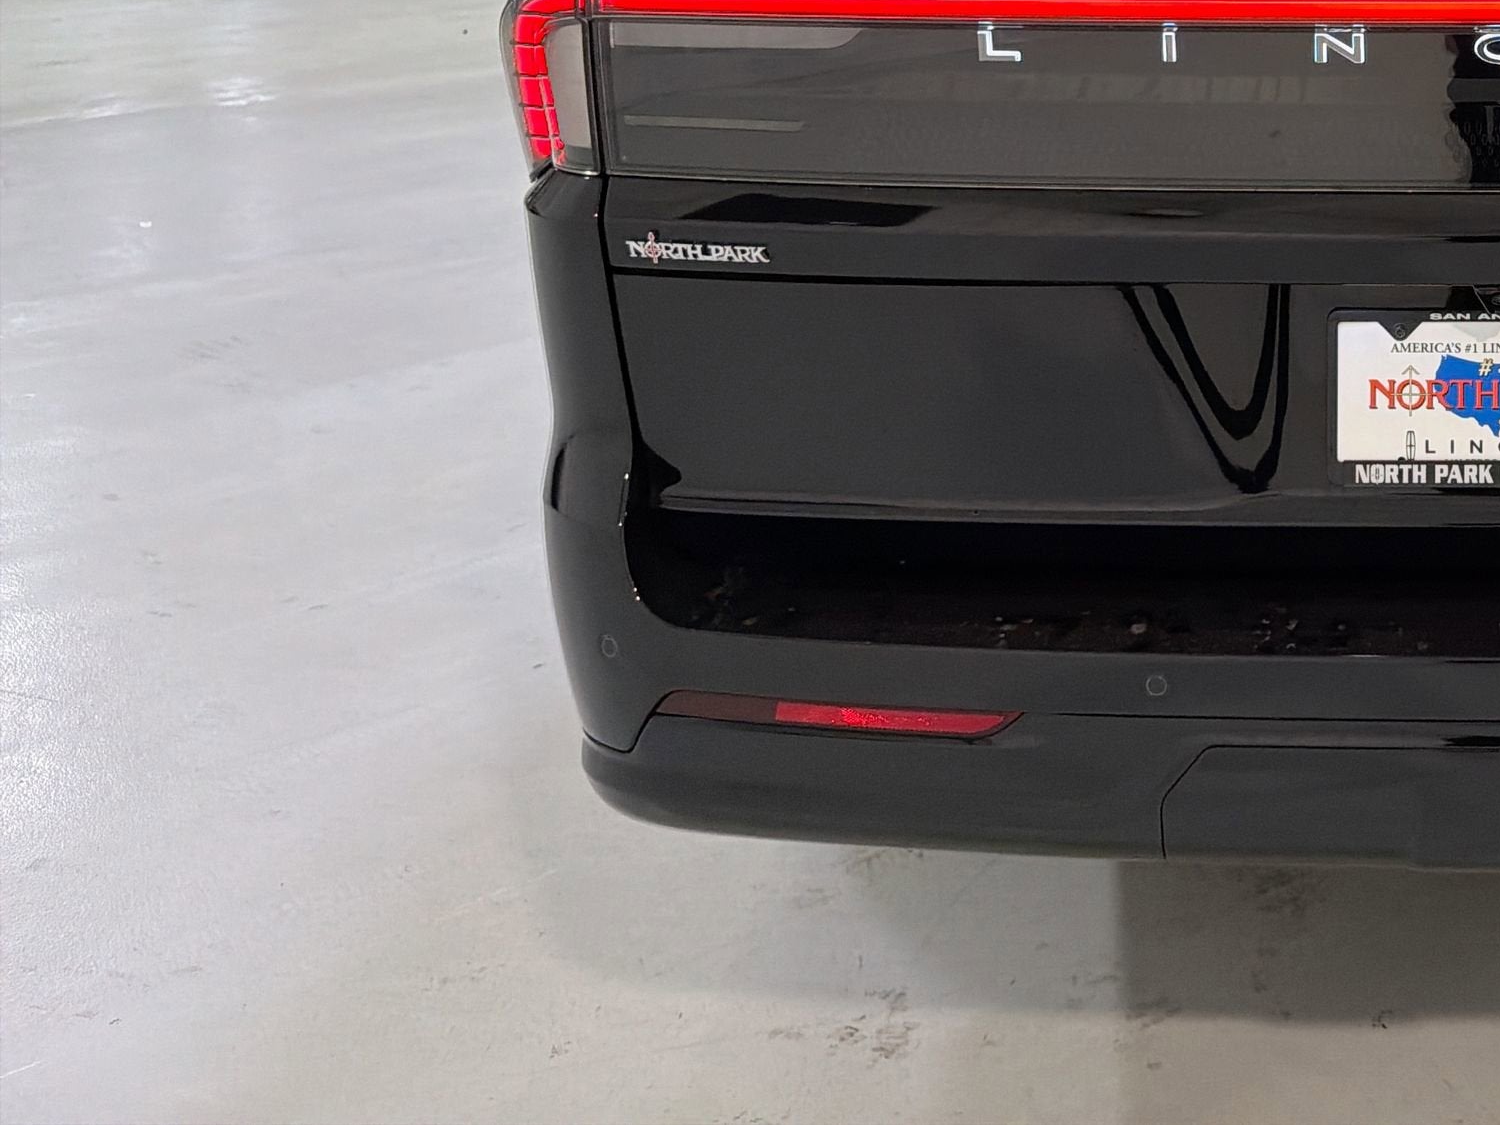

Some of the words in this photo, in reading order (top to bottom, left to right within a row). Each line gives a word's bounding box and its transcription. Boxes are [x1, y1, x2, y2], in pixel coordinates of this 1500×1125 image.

[625, 236, 705, 263] NORTH
[707, 245, 770, 263] PARK
[1429, 312, 1472, 321] SAN
[1390, 342, 1462, 354] AMERICA'S
[1465, 342, 1478, 354] #1
[1369, 378, 1500, 410] NORTH
[1355, 464, 1427, 484] NORTH
[1434, 464, 1494, 484] PARK
